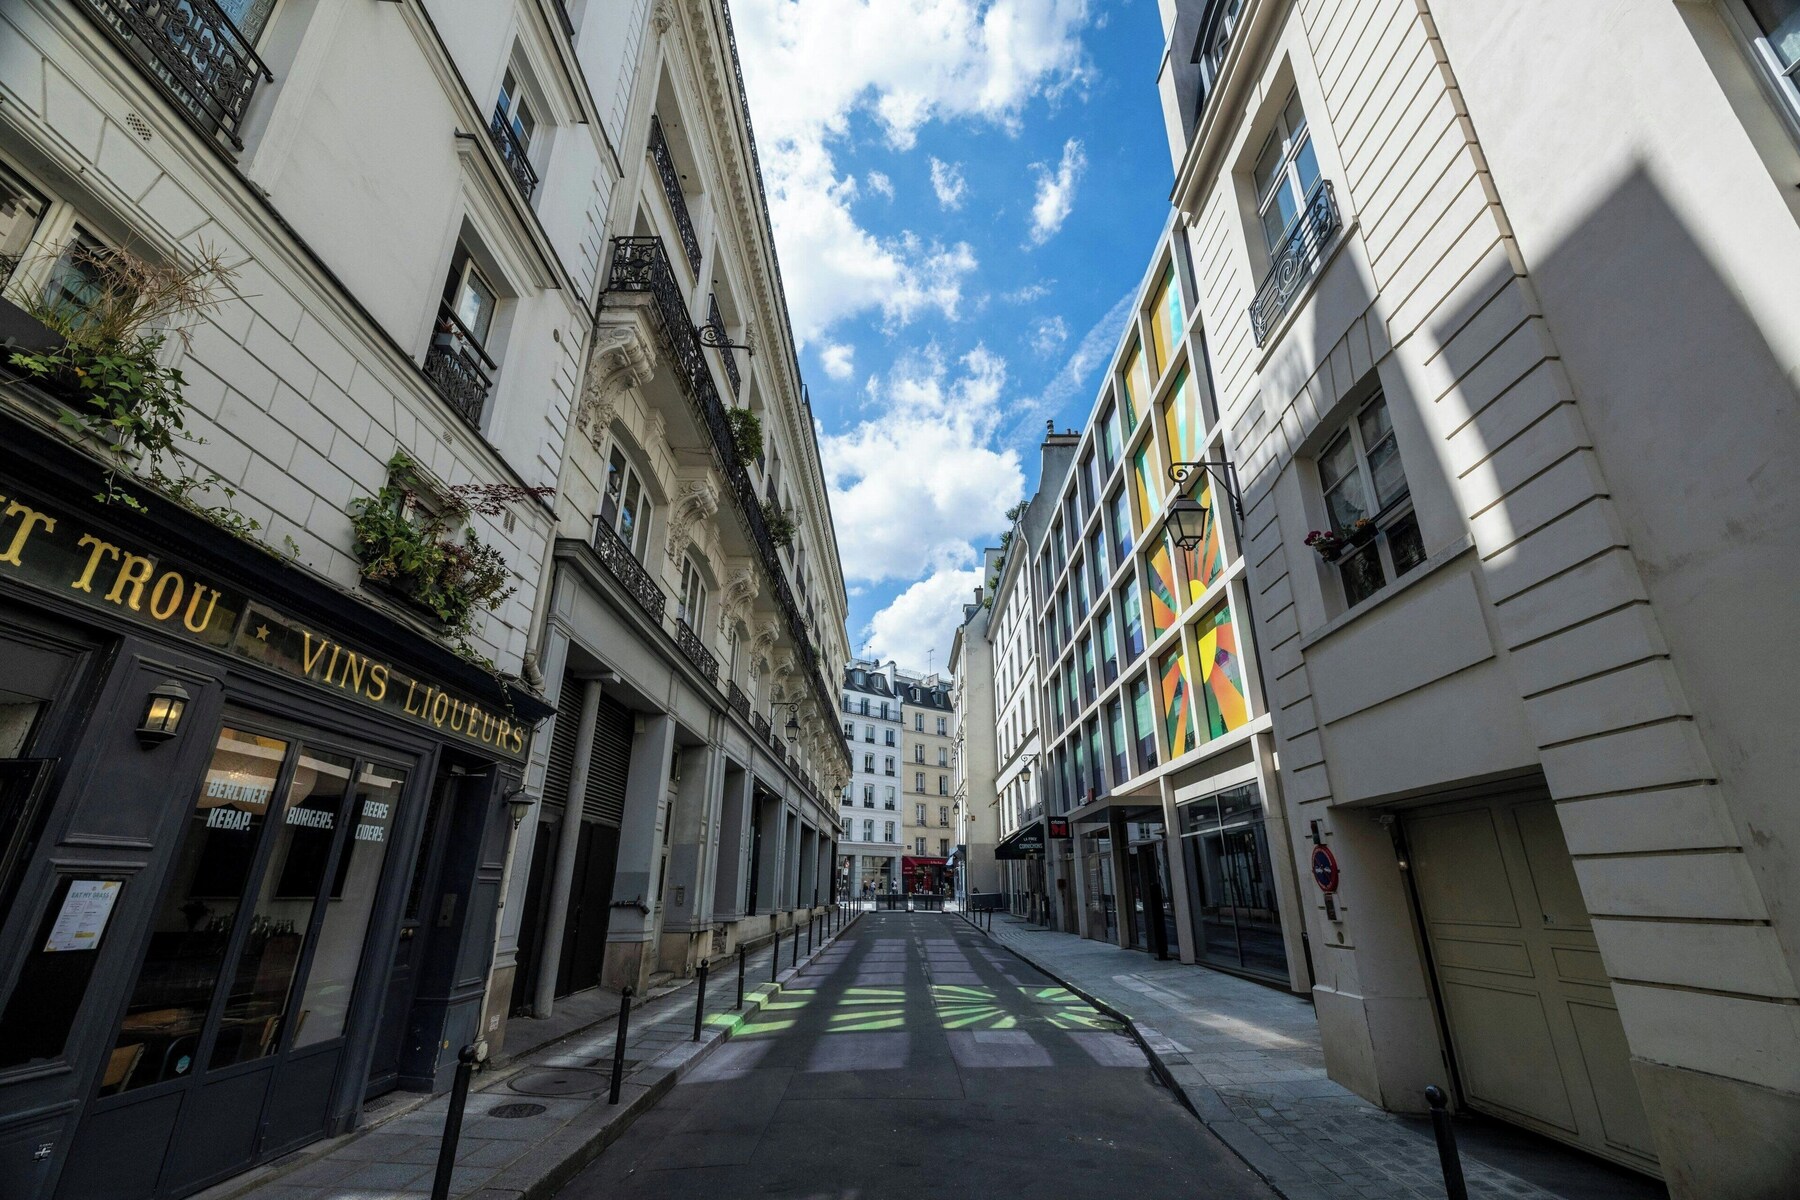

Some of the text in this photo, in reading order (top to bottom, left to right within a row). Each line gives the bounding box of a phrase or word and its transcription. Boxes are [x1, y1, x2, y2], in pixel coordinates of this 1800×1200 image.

[0, 494, 222, 633] T TROU
[302, 629, 524, 754] VINS LIQUEURS
[206, 779, 269, 804] BERLINER
[206, 807, 252, 831] KEBAP.
[286, 806, 334, 830] BURGERS.
[362, 800, 390, 819] BEERS
[355, 823, 385, 842] CIDERS.
